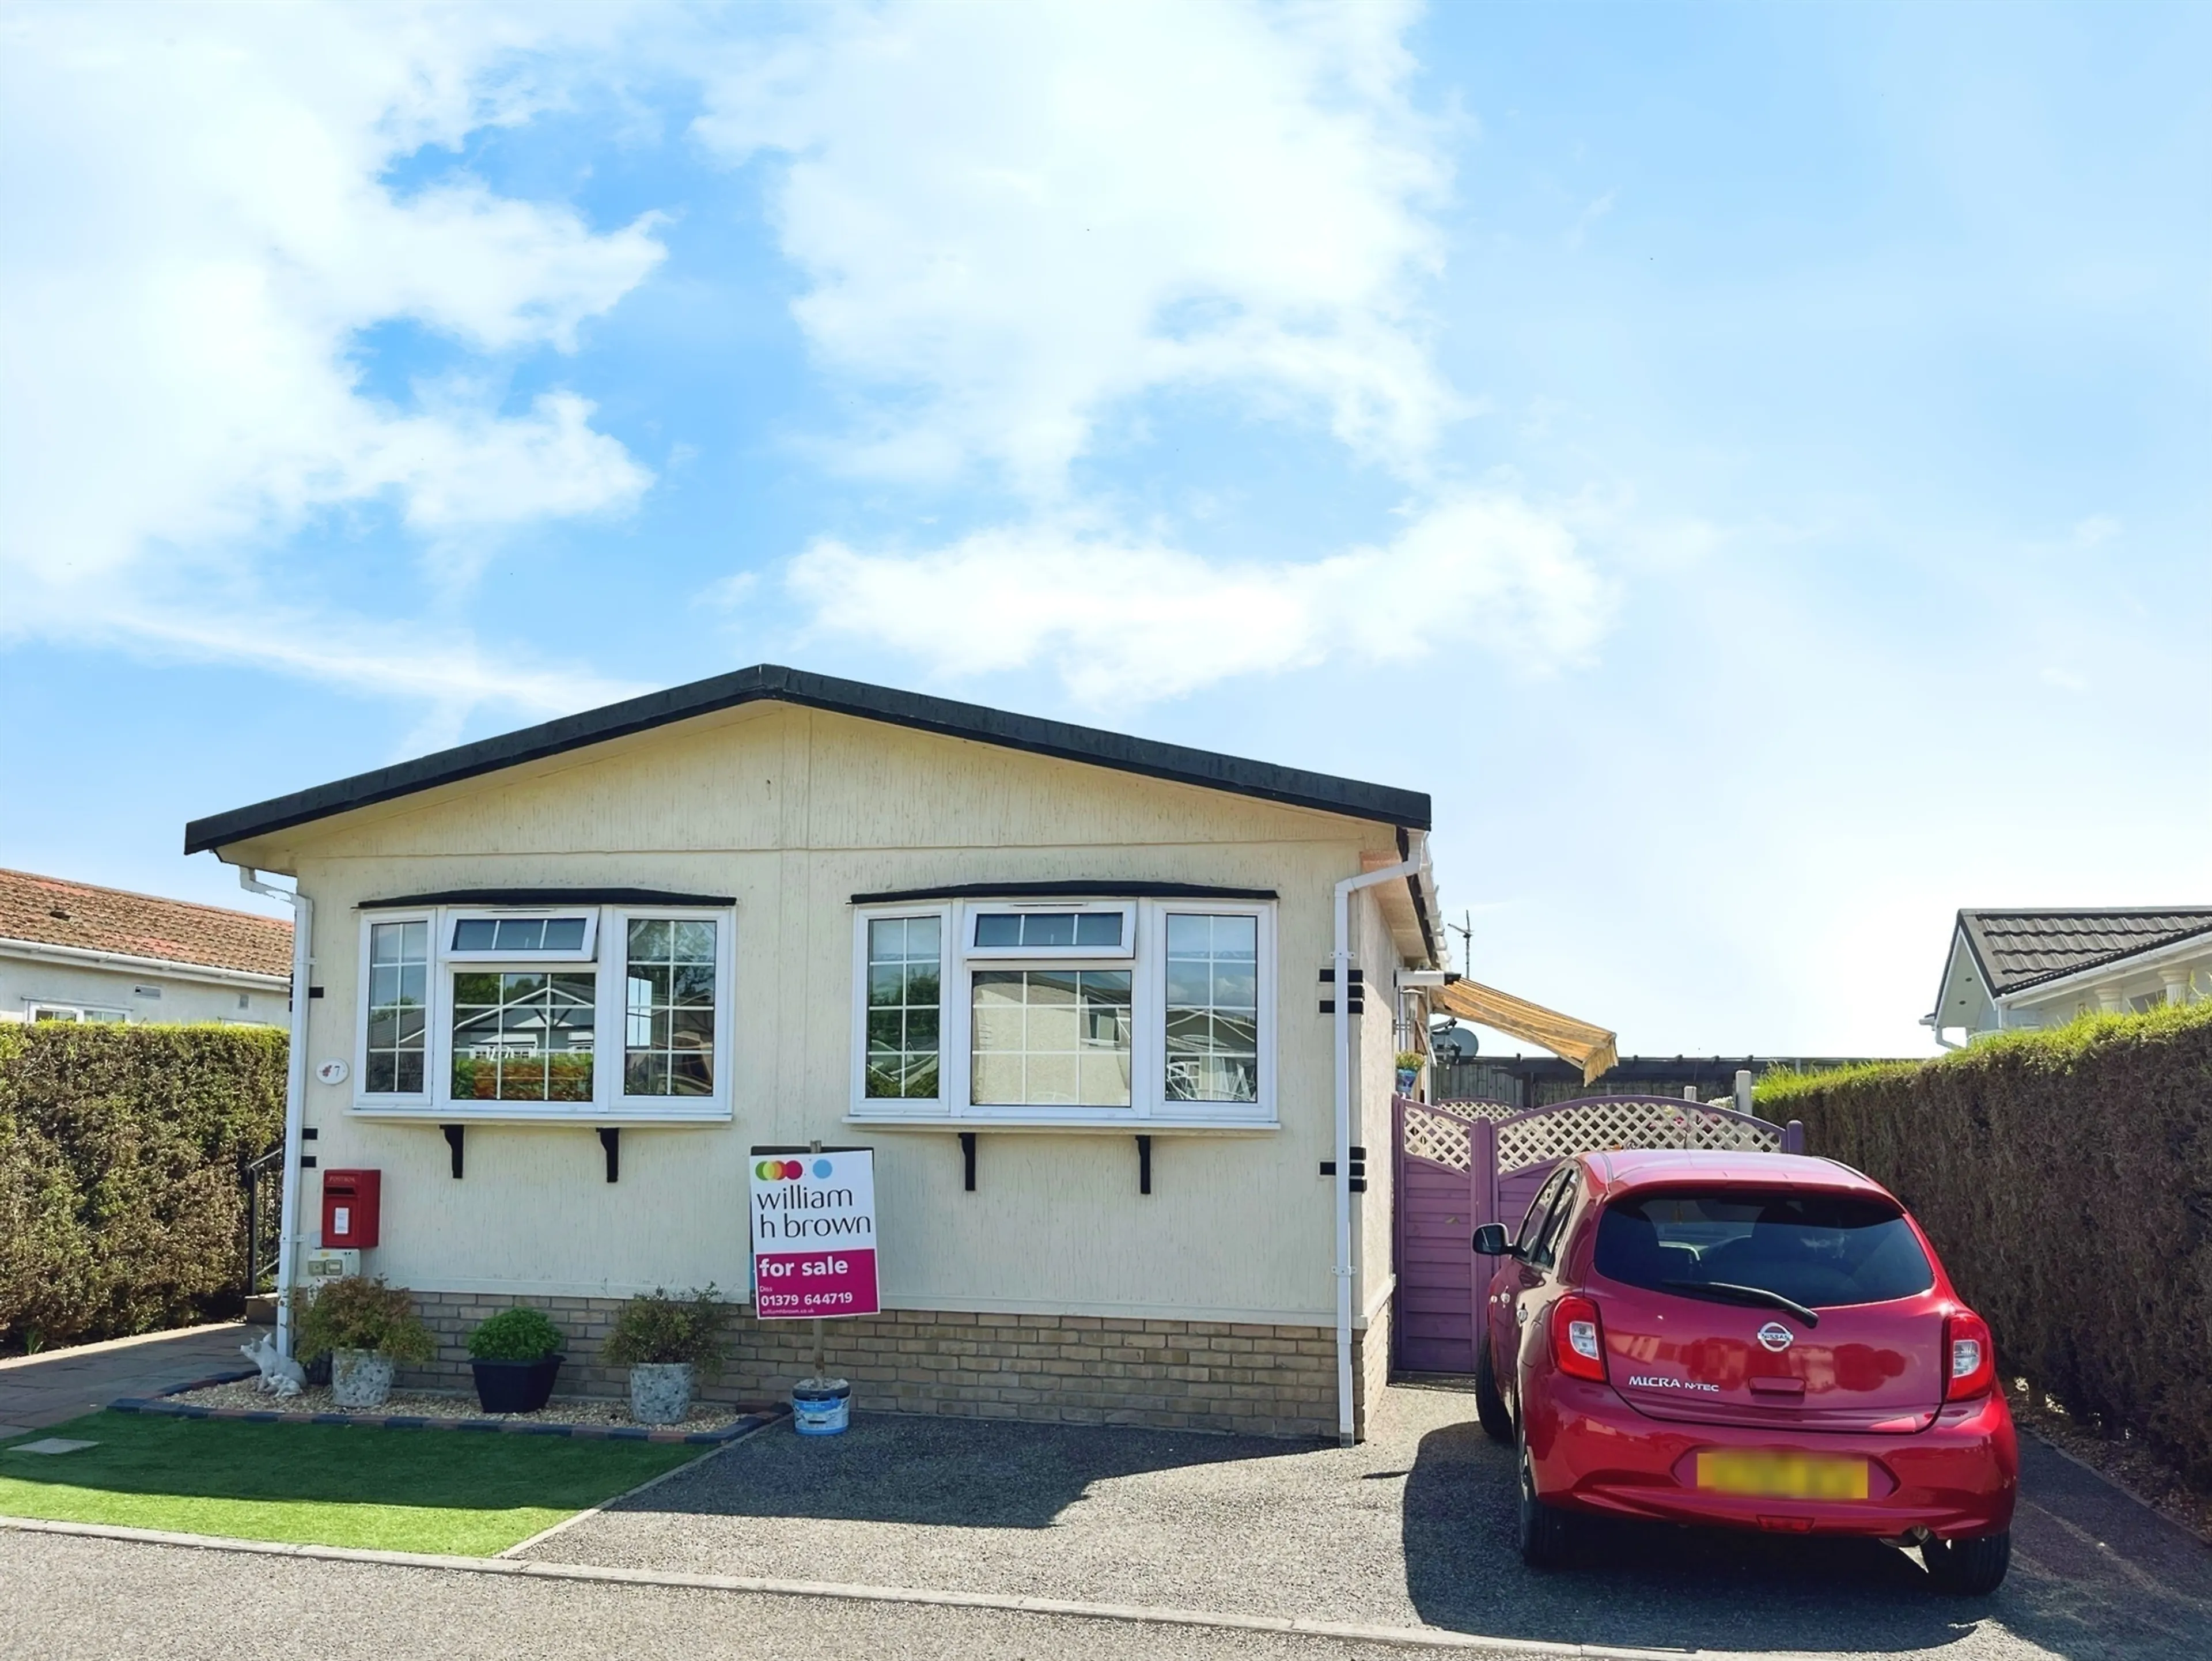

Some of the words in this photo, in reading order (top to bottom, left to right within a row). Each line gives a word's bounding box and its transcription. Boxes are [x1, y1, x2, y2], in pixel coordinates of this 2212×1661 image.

[334, 1065, 340, 1077] 7
[756, 1185, 853, 1210] william
[760, 1214, 775, 1238] h
[784, 1213, 871, 1238] brown
[759, 1258, 794, 1277] for
[801, 1256, 849, 1276] sale
[761, 1294, 799, 1306] 01379
[804, 1292, 853, 1305] 644719
[1629, 1376, 1681, 1388] MICRA
